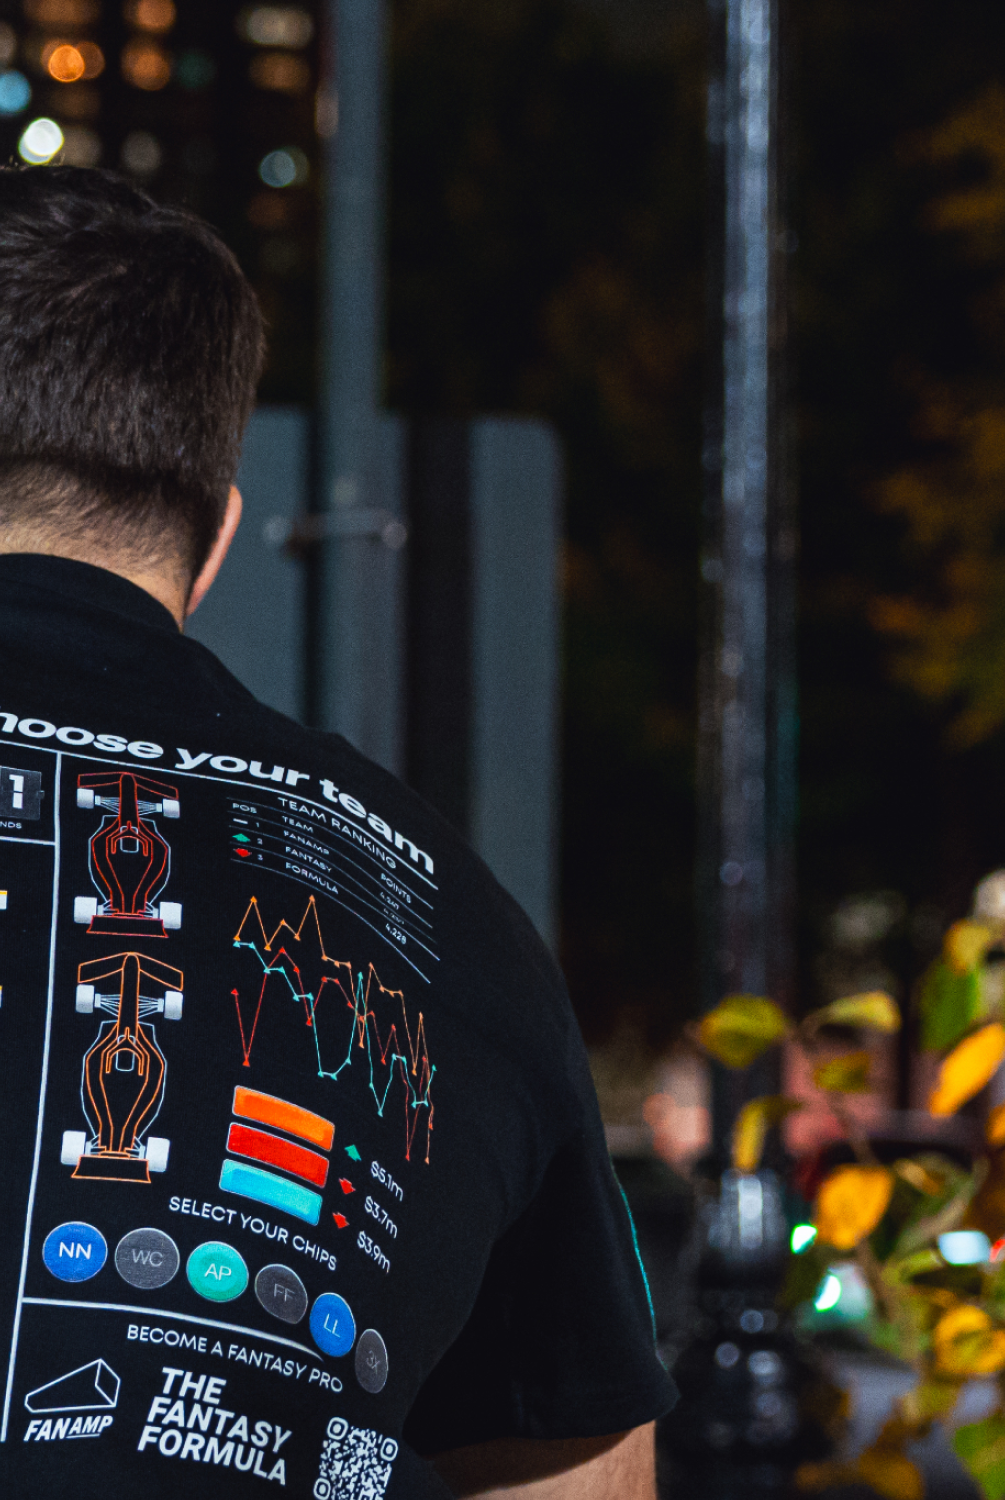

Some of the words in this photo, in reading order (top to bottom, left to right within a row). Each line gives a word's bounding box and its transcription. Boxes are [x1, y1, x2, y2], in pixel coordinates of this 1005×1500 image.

[174, 747, 310, 786] your
[319, 778, 434, 874] team
[232, 803, 257, 814] POS
[282, 816, 314, 833] TEAM
[380, 873, 411, 904] POINTS
[278, 797, 327, 823] TEAM
[332, 818, 396, 869] RANKING
[284, 830, 330, 855] FANAMP
[285, 846, 332, 873] FANTASY
[285, 862, 338, 894] FORMULA
[370, 1160, 404, 1202] $5.1m
[169, 1196, 236, 1224] SELECT
[241, 1213, 288, 1244] YOUR
[292, 1236, 337, 1271] CHIPS
[364, 1196, 398, 1238] $3.7m
[58, 1241, 92, 1259] NN
[130, 1249, 163, 1267] WC
[204, 1262, 232, 1280] AP
[357, 1231, 391, 1274] $3.9m
[323, 1314, 341, 1337] LL
[127, 1325, 208, 1353] BECOME
[211, 1341, 224, 1356] A
[228, 1344, 307, 1380] FANTASY
[309, 1370, 343, 1393] PRO
[160, 1367, 226, 1404] THE
[24, 1415, 114, 1442] FANAMP
[148, 1397, 292, 1452] FANTASY
[138, 1426, 287, 1486] FORMULA
